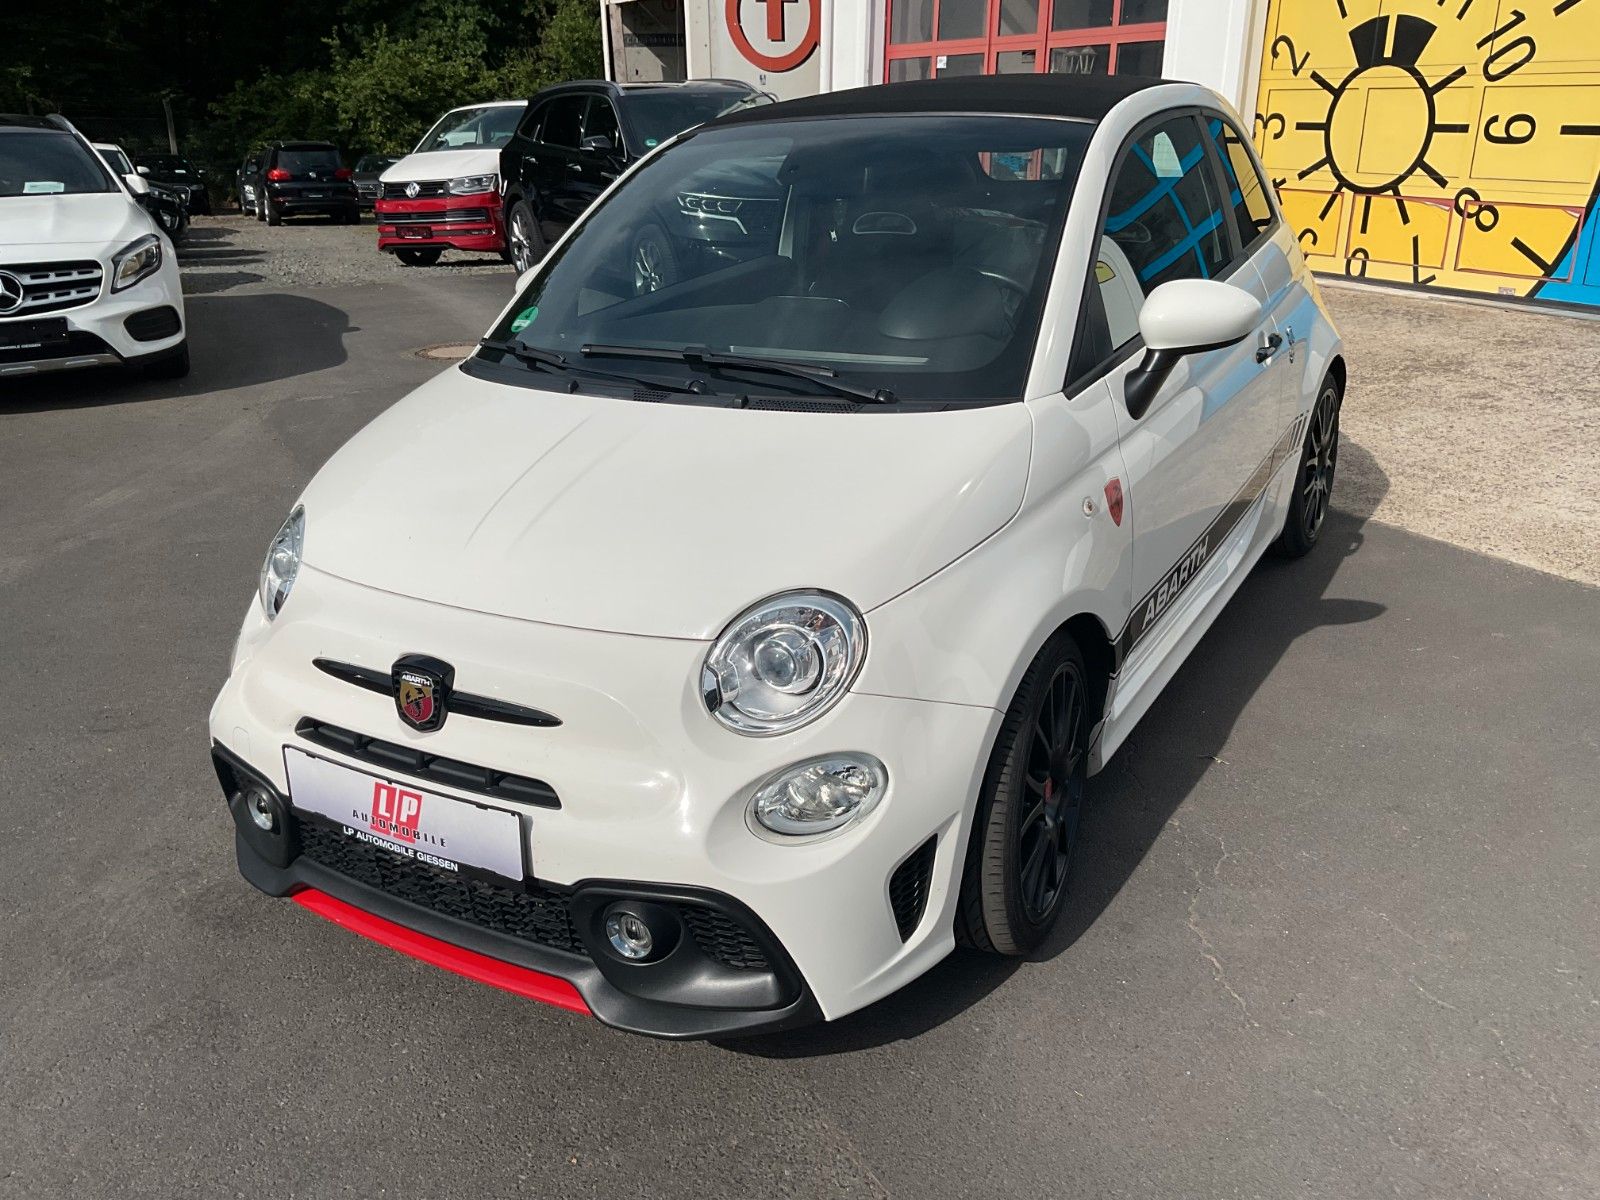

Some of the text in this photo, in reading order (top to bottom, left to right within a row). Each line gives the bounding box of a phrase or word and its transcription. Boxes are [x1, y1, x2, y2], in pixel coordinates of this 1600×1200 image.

[1271, 34, 1311, 77] 2
[1476, 9, 1536, 82] 10
[1254, 112, 1286, 140] 3
[1454, 187, 1500, 233] 8
[1142, 535, 1209, 631] ABARTH
[401, 674, 430, 686] ABARTH
[378, 788, 419, 823] LP
[343, 825, 459, 872] LP AUTOMOBILE GIESSEN
[352, 809, 447, 848] AUTOMOBILE
